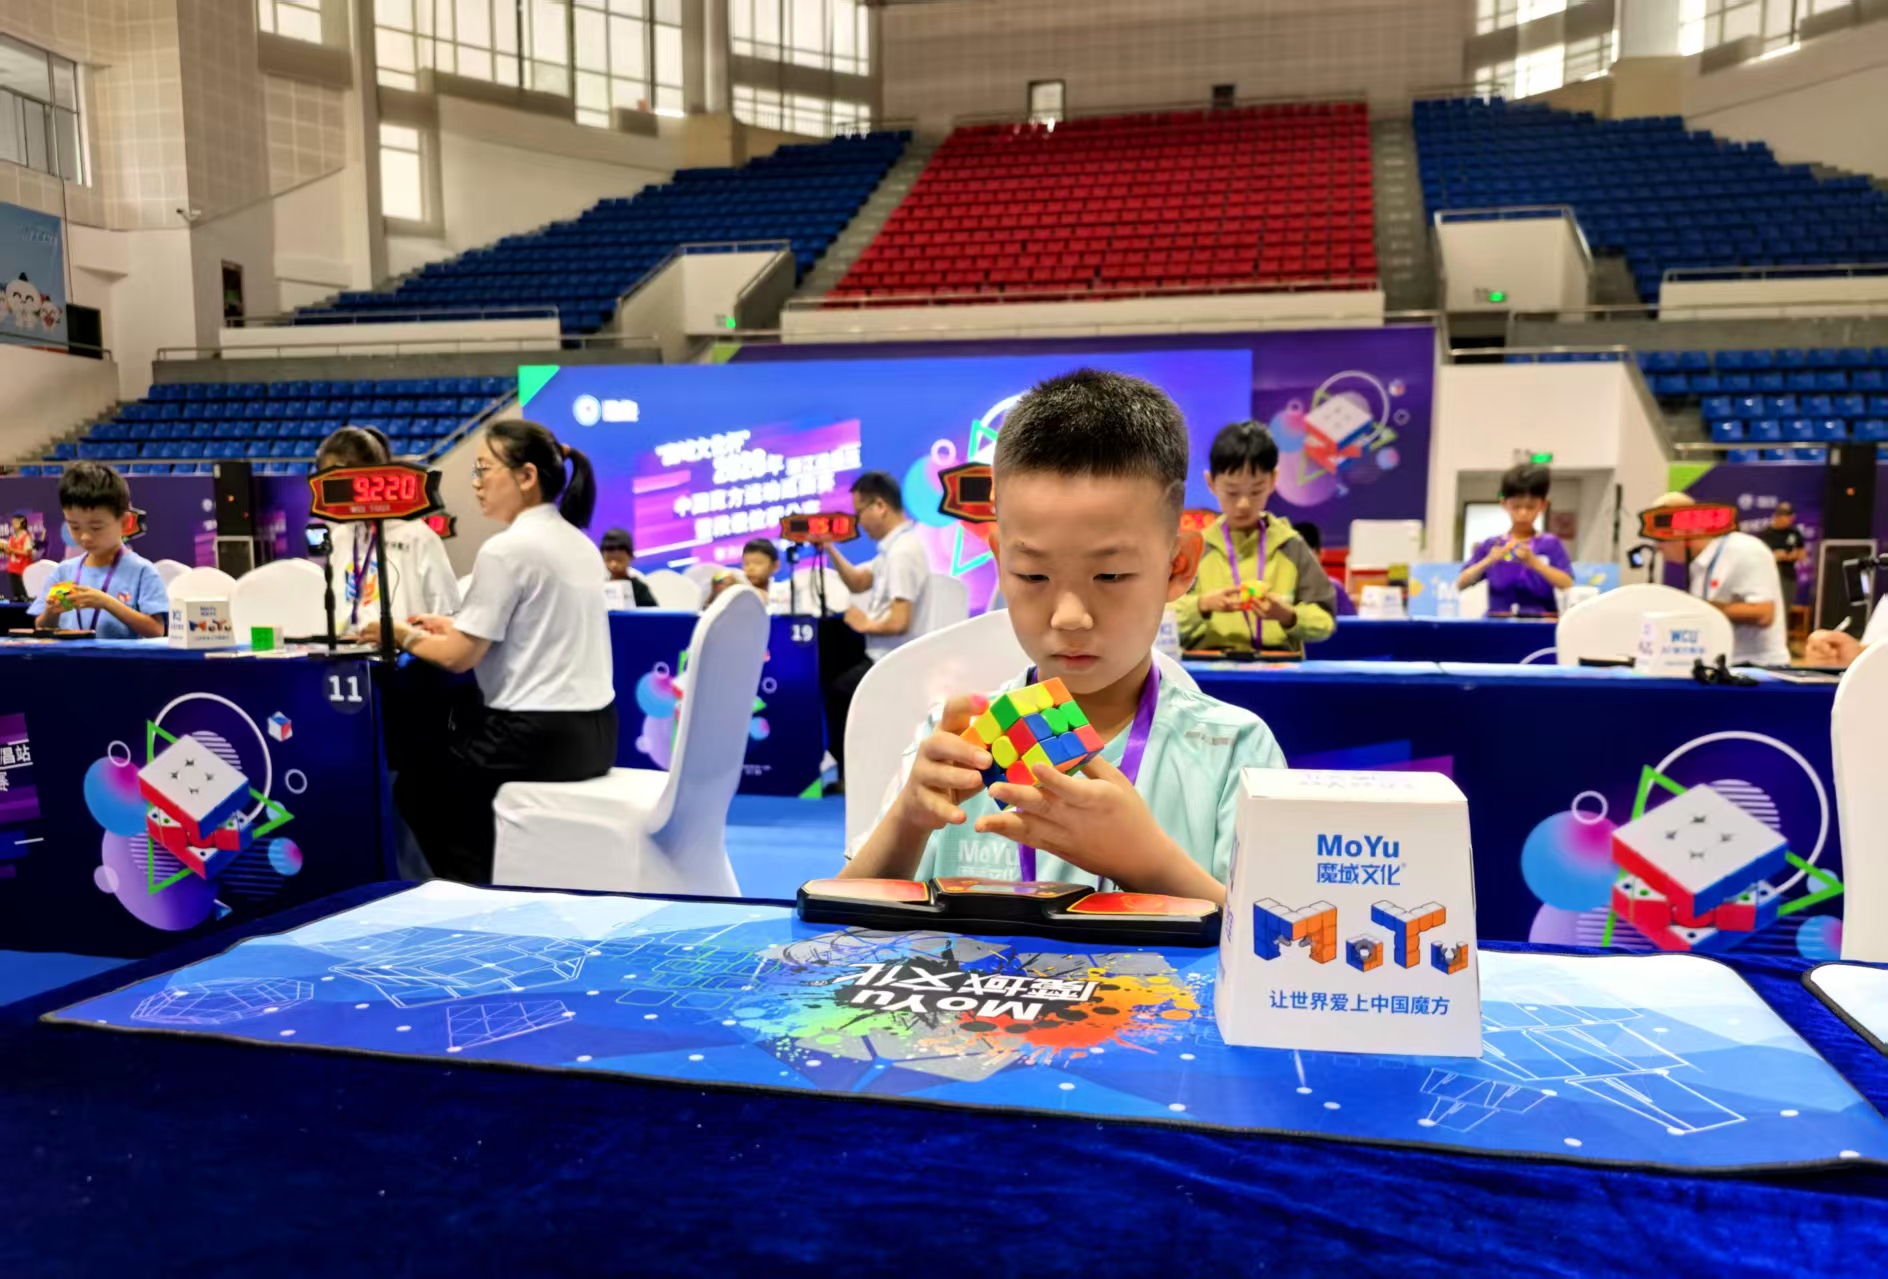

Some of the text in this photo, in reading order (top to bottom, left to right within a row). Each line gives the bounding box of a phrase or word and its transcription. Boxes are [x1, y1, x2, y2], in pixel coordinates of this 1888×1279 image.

[792, 624, 813, 641] 19
[329, 675, 362, 702] 11
[0, 744, 31, 765] 昌站
[1317, 834, 1400, 859] MoYu
[1316, 862, 1401, 886] 魔域文化
[832, 963, 1100, 1002] 魔域文化
[851, 989, 1043, 1021] MoYu
[1269, 989, 1450, 1016] 让世界爱上中国魔方
